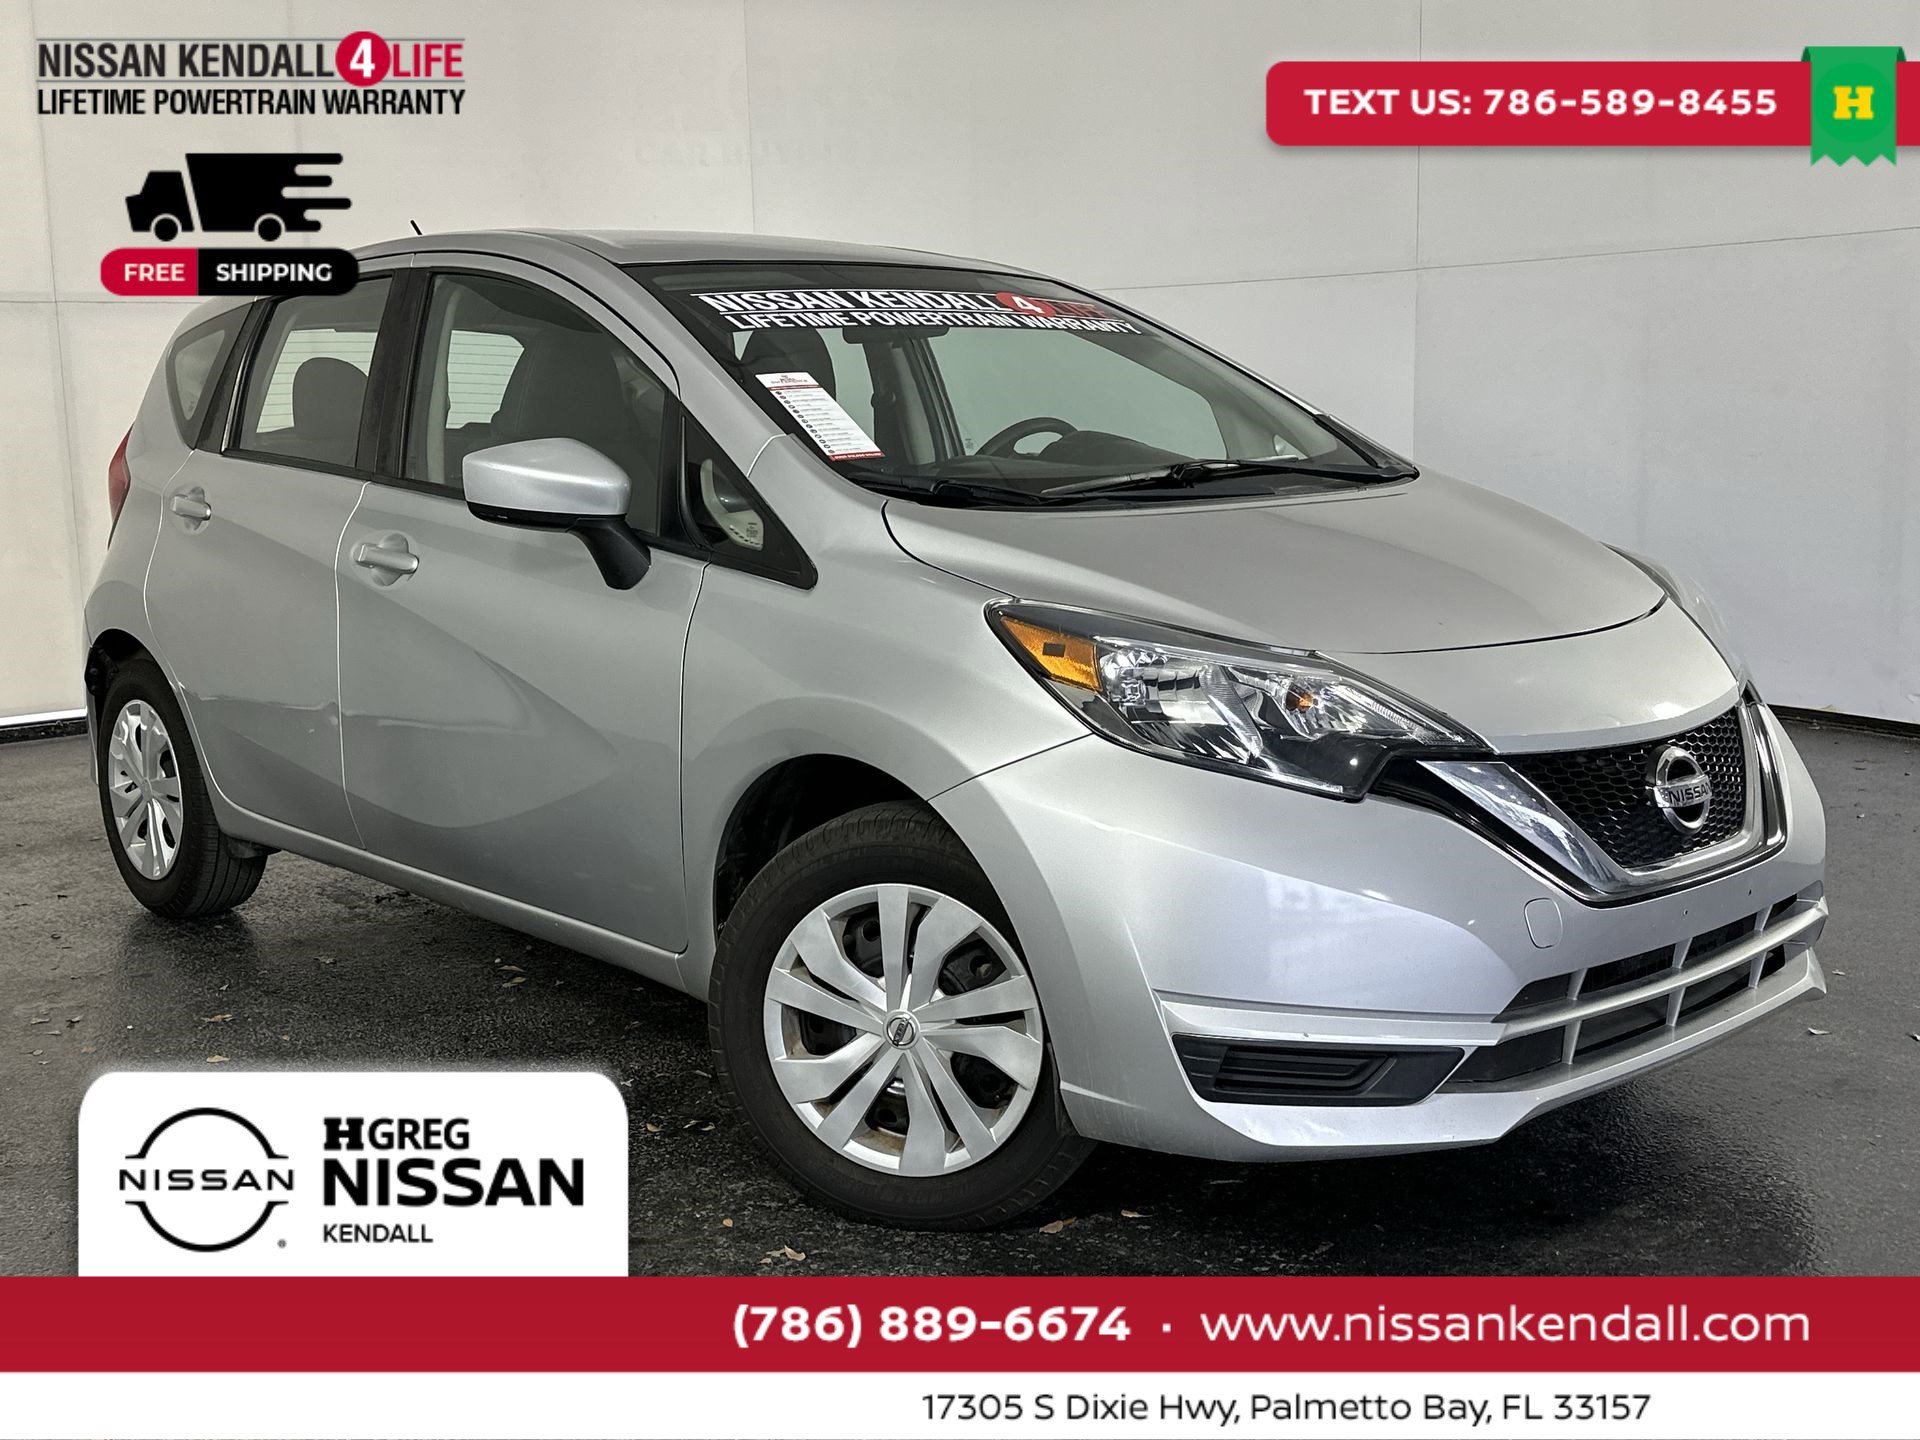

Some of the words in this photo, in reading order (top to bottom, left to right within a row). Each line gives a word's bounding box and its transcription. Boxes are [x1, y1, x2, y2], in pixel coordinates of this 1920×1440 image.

[699, 292, 855, 312] NISSAN
[847, 291, 1013, 312] KENDALL
[1011, 296, 1045, 314] 4
[724, 311, 859, 330] LIFETIME
[850, 311, 1013, 327] POWERTRAIN
[1012, 315, 1142, 335] WARRANTY
[1668, 782, 1711, 802] NISSAN
